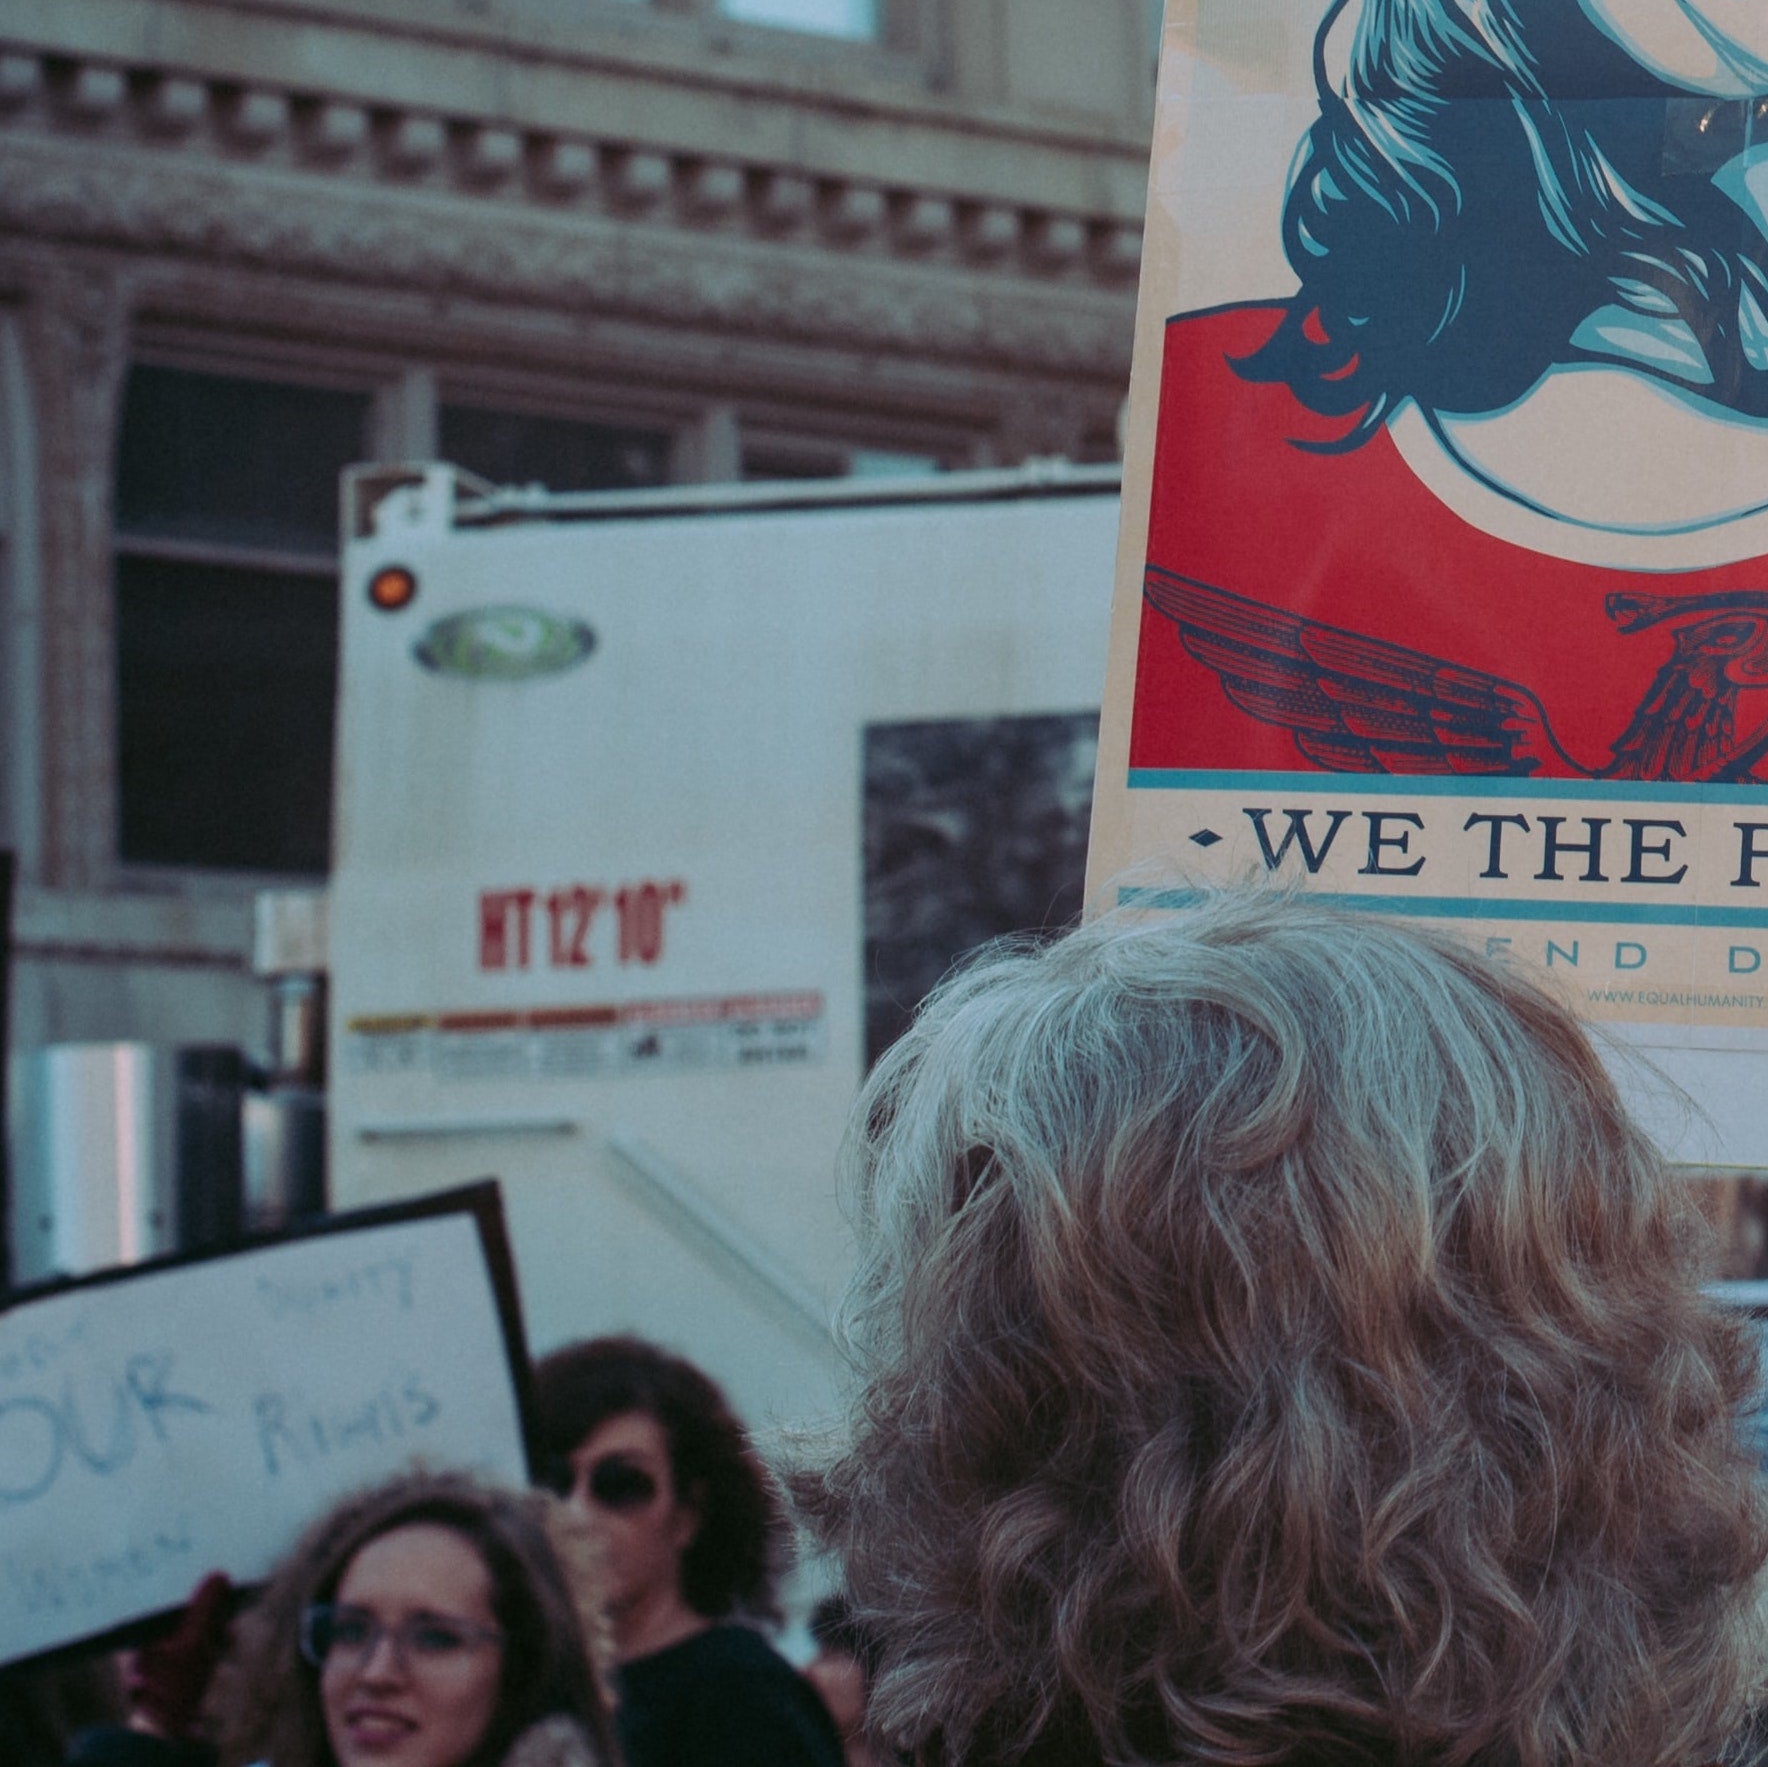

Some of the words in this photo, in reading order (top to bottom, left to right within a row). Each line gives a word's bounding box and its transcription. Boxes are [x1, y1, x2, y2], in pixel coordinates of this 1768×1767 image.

[1242, 808, 1426, 876] WE
[1463, 813, 1689, 884] THE
[481, 888, 534, 969] HT
[1486, 937, 1649, 970] END
